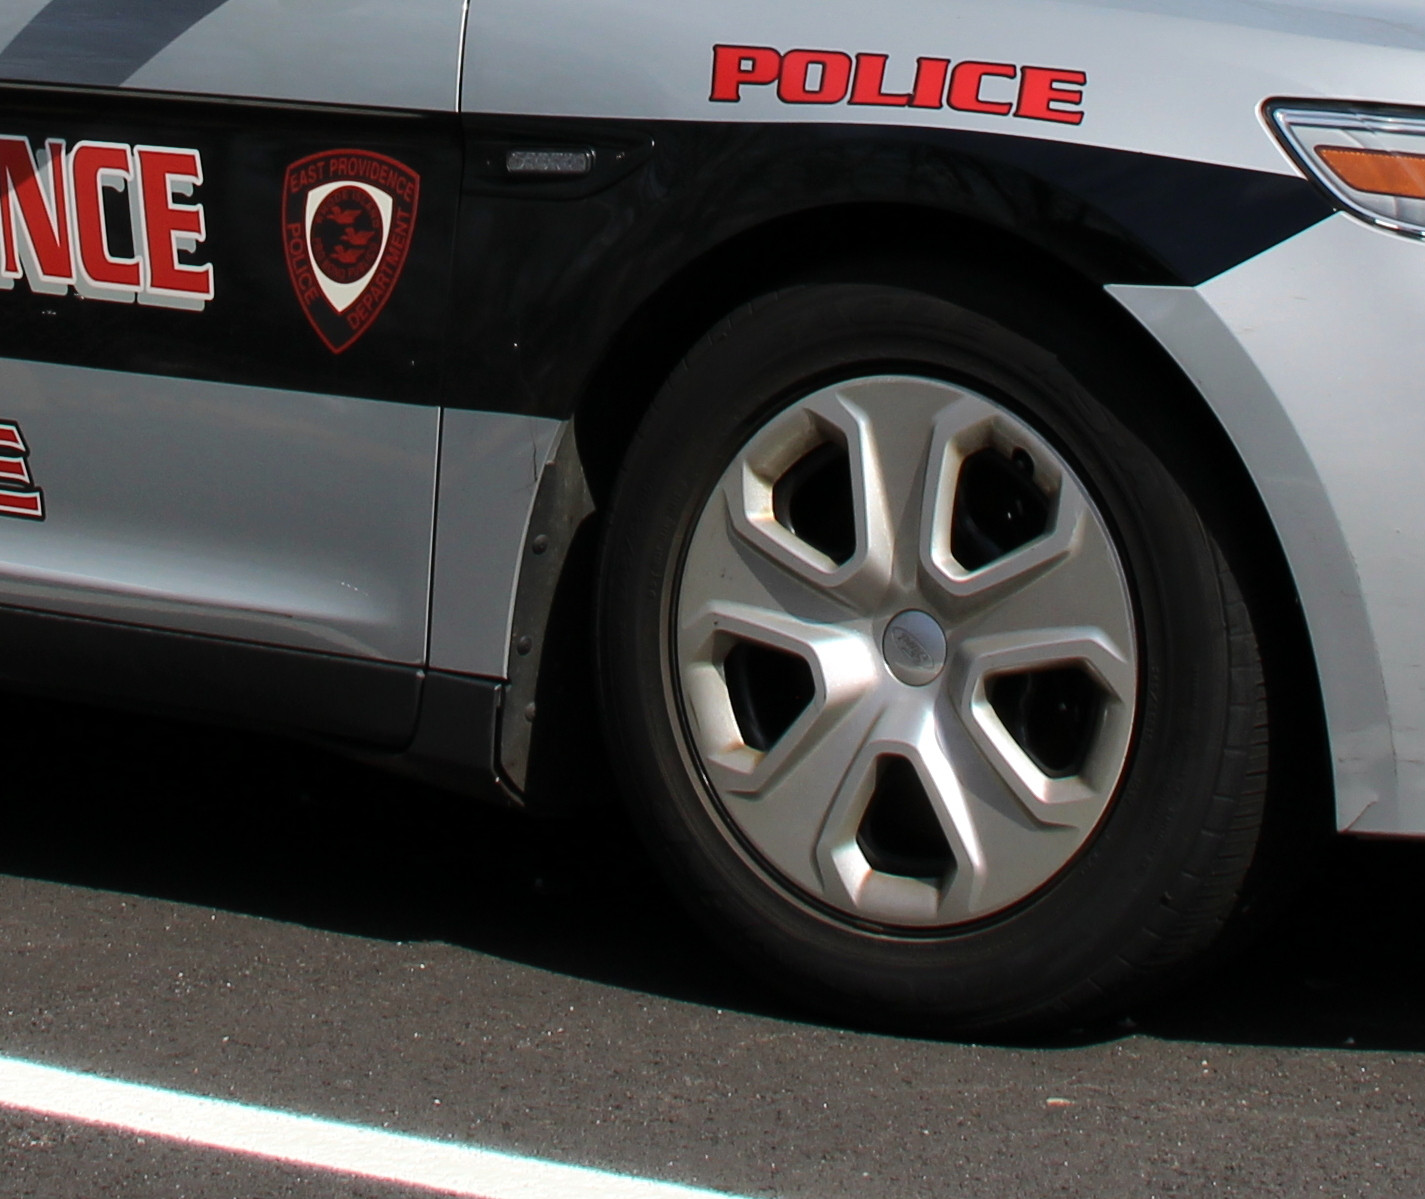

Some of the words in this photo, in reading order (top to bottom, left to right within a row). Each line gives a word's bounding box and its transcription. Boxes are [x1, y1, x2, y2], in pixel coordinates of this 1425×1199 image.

[709, 44, 1087, 125] POLICE
[290, 160, 325, 193] EAST
[329, 157, 415, 202] PROVIDENCE
[287, 222, 320, 306] POLICE
[347, 206, 411, 330] DEPARTMENT
